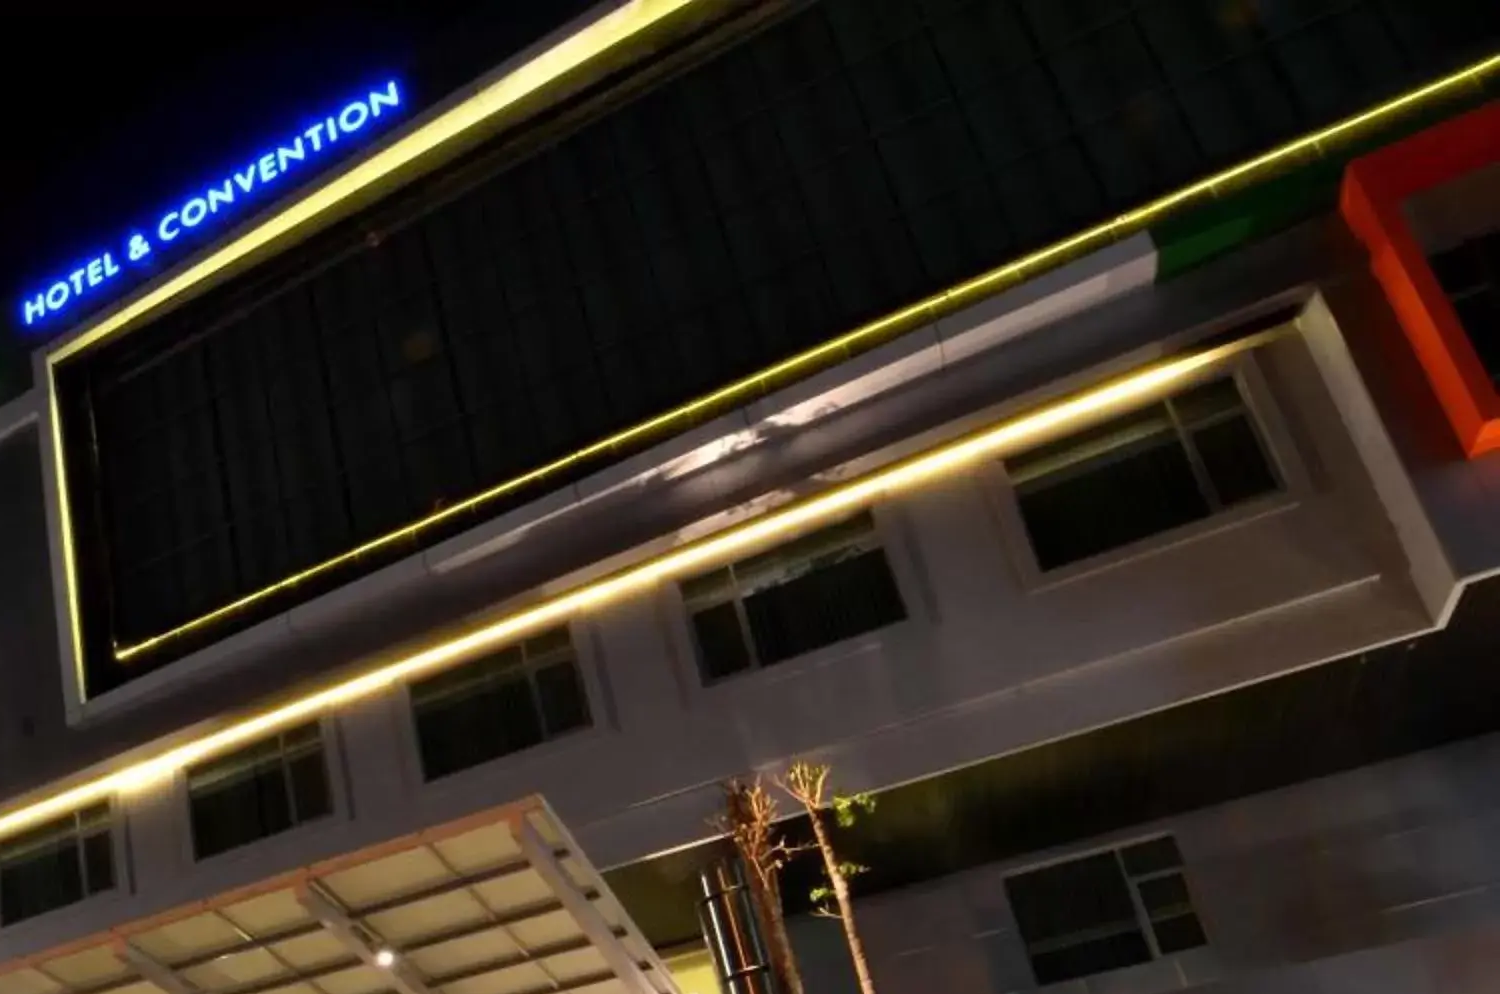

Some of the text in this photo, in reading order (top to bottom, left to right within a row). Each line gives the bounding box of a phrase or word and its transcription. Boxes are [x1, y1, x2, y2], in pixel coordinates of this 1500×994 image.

[23, 80, 401, 325] HOTEL & CONVENTION
